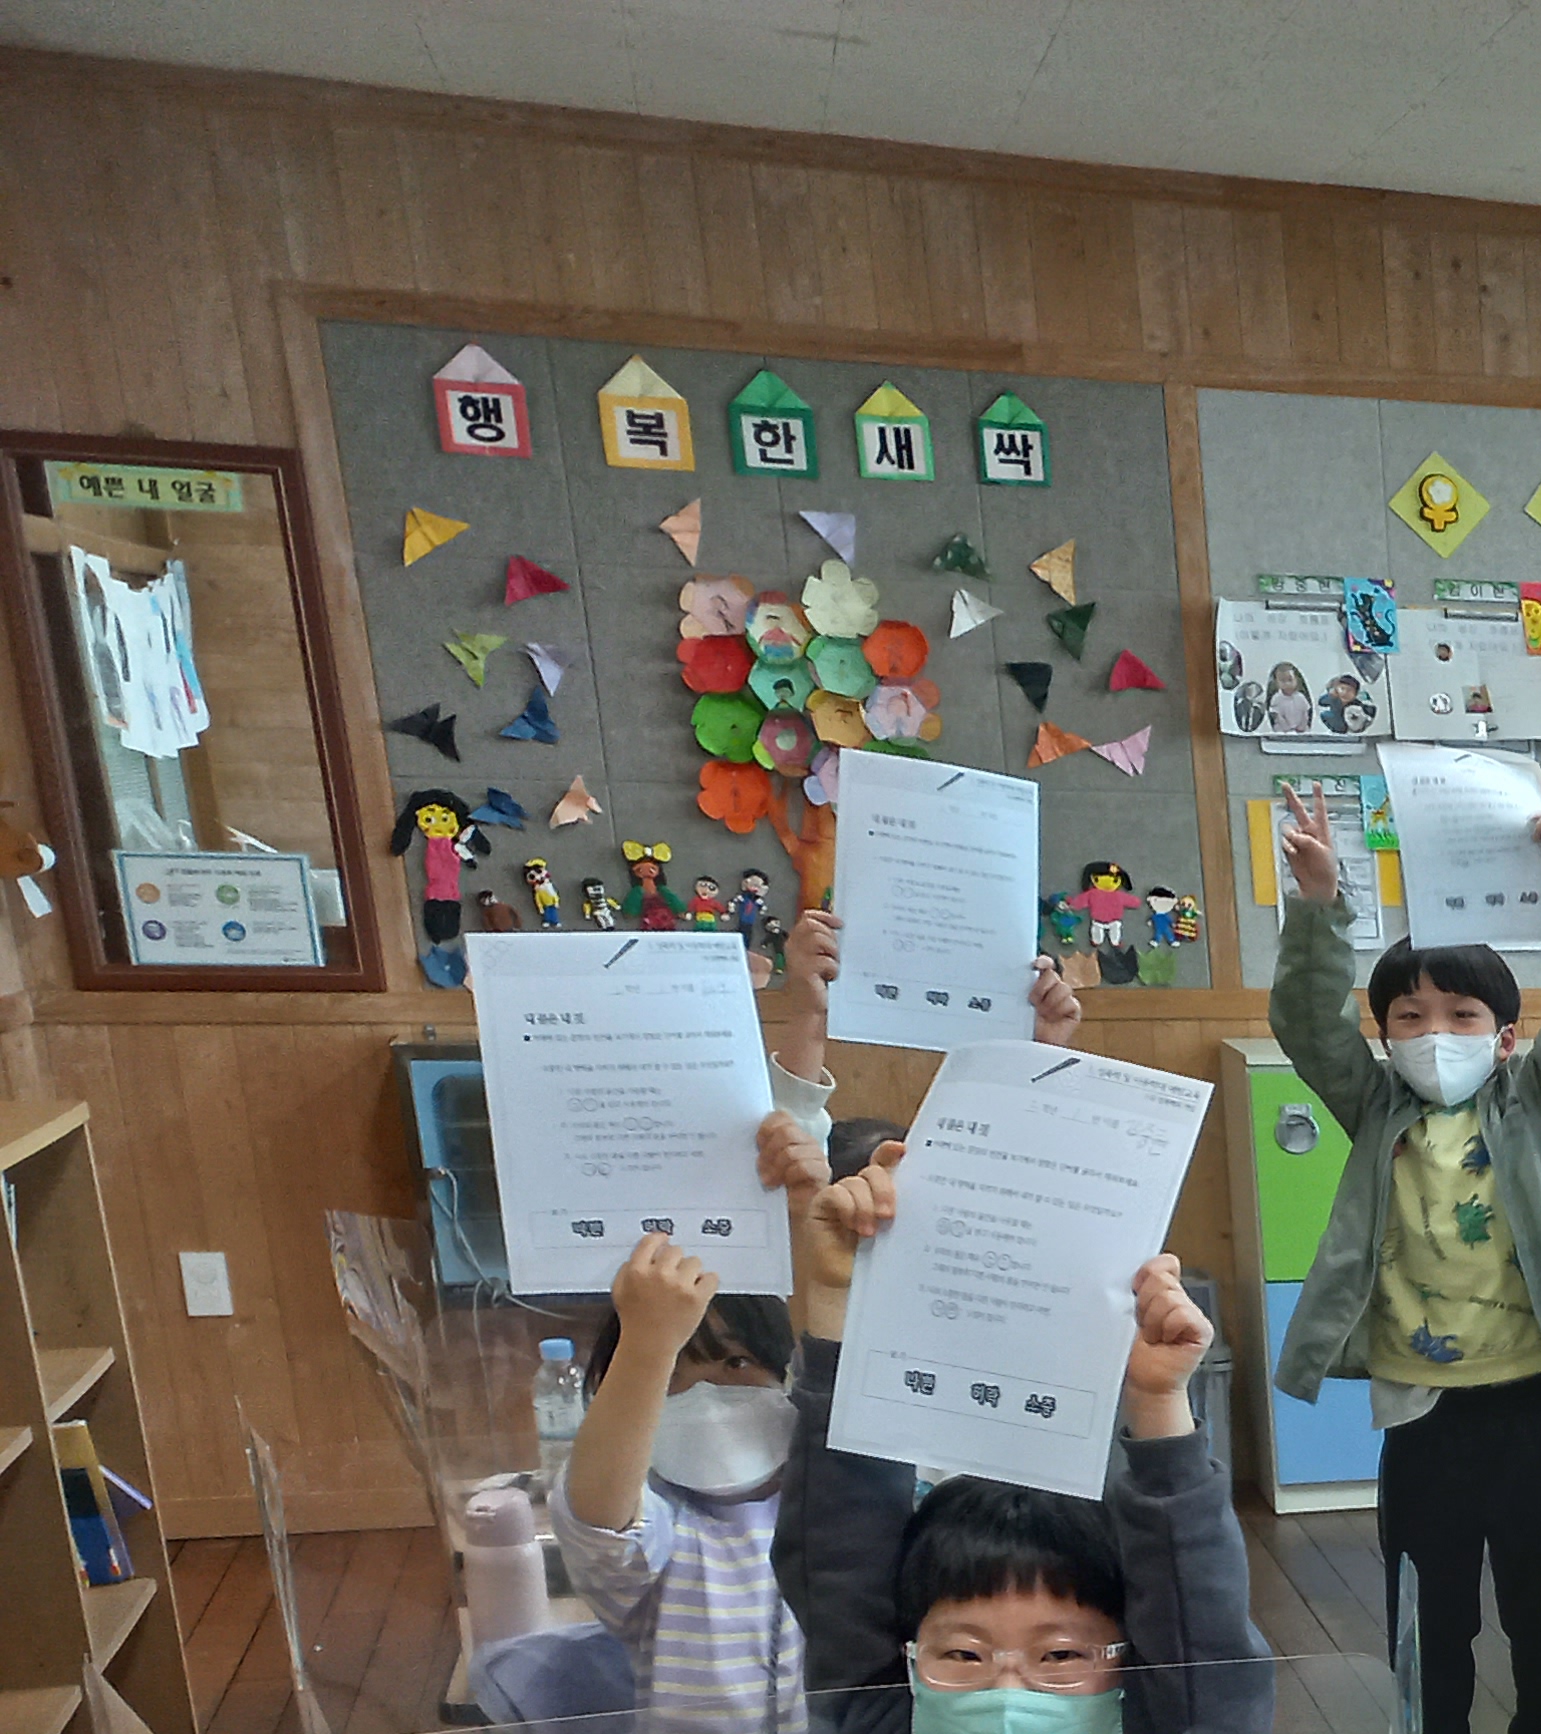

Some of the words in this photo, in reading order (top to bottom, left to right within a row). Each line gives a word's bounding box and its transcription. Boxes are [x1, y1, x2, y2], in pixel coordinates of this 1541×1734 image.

[457, 395, 505, 444] 행
[625, 409, 669, 458] 복
[752, 419, 797, 466] 한
[875, 425, 917, 472] 새
[993, 433, 1035, 478] 싹
[79, 475, 125, 498] 예쁜
[137, 477, 160, 501] 내
[170, 479, 216, 504] 얼굴
[1419, 473, 1459, 533] 우
